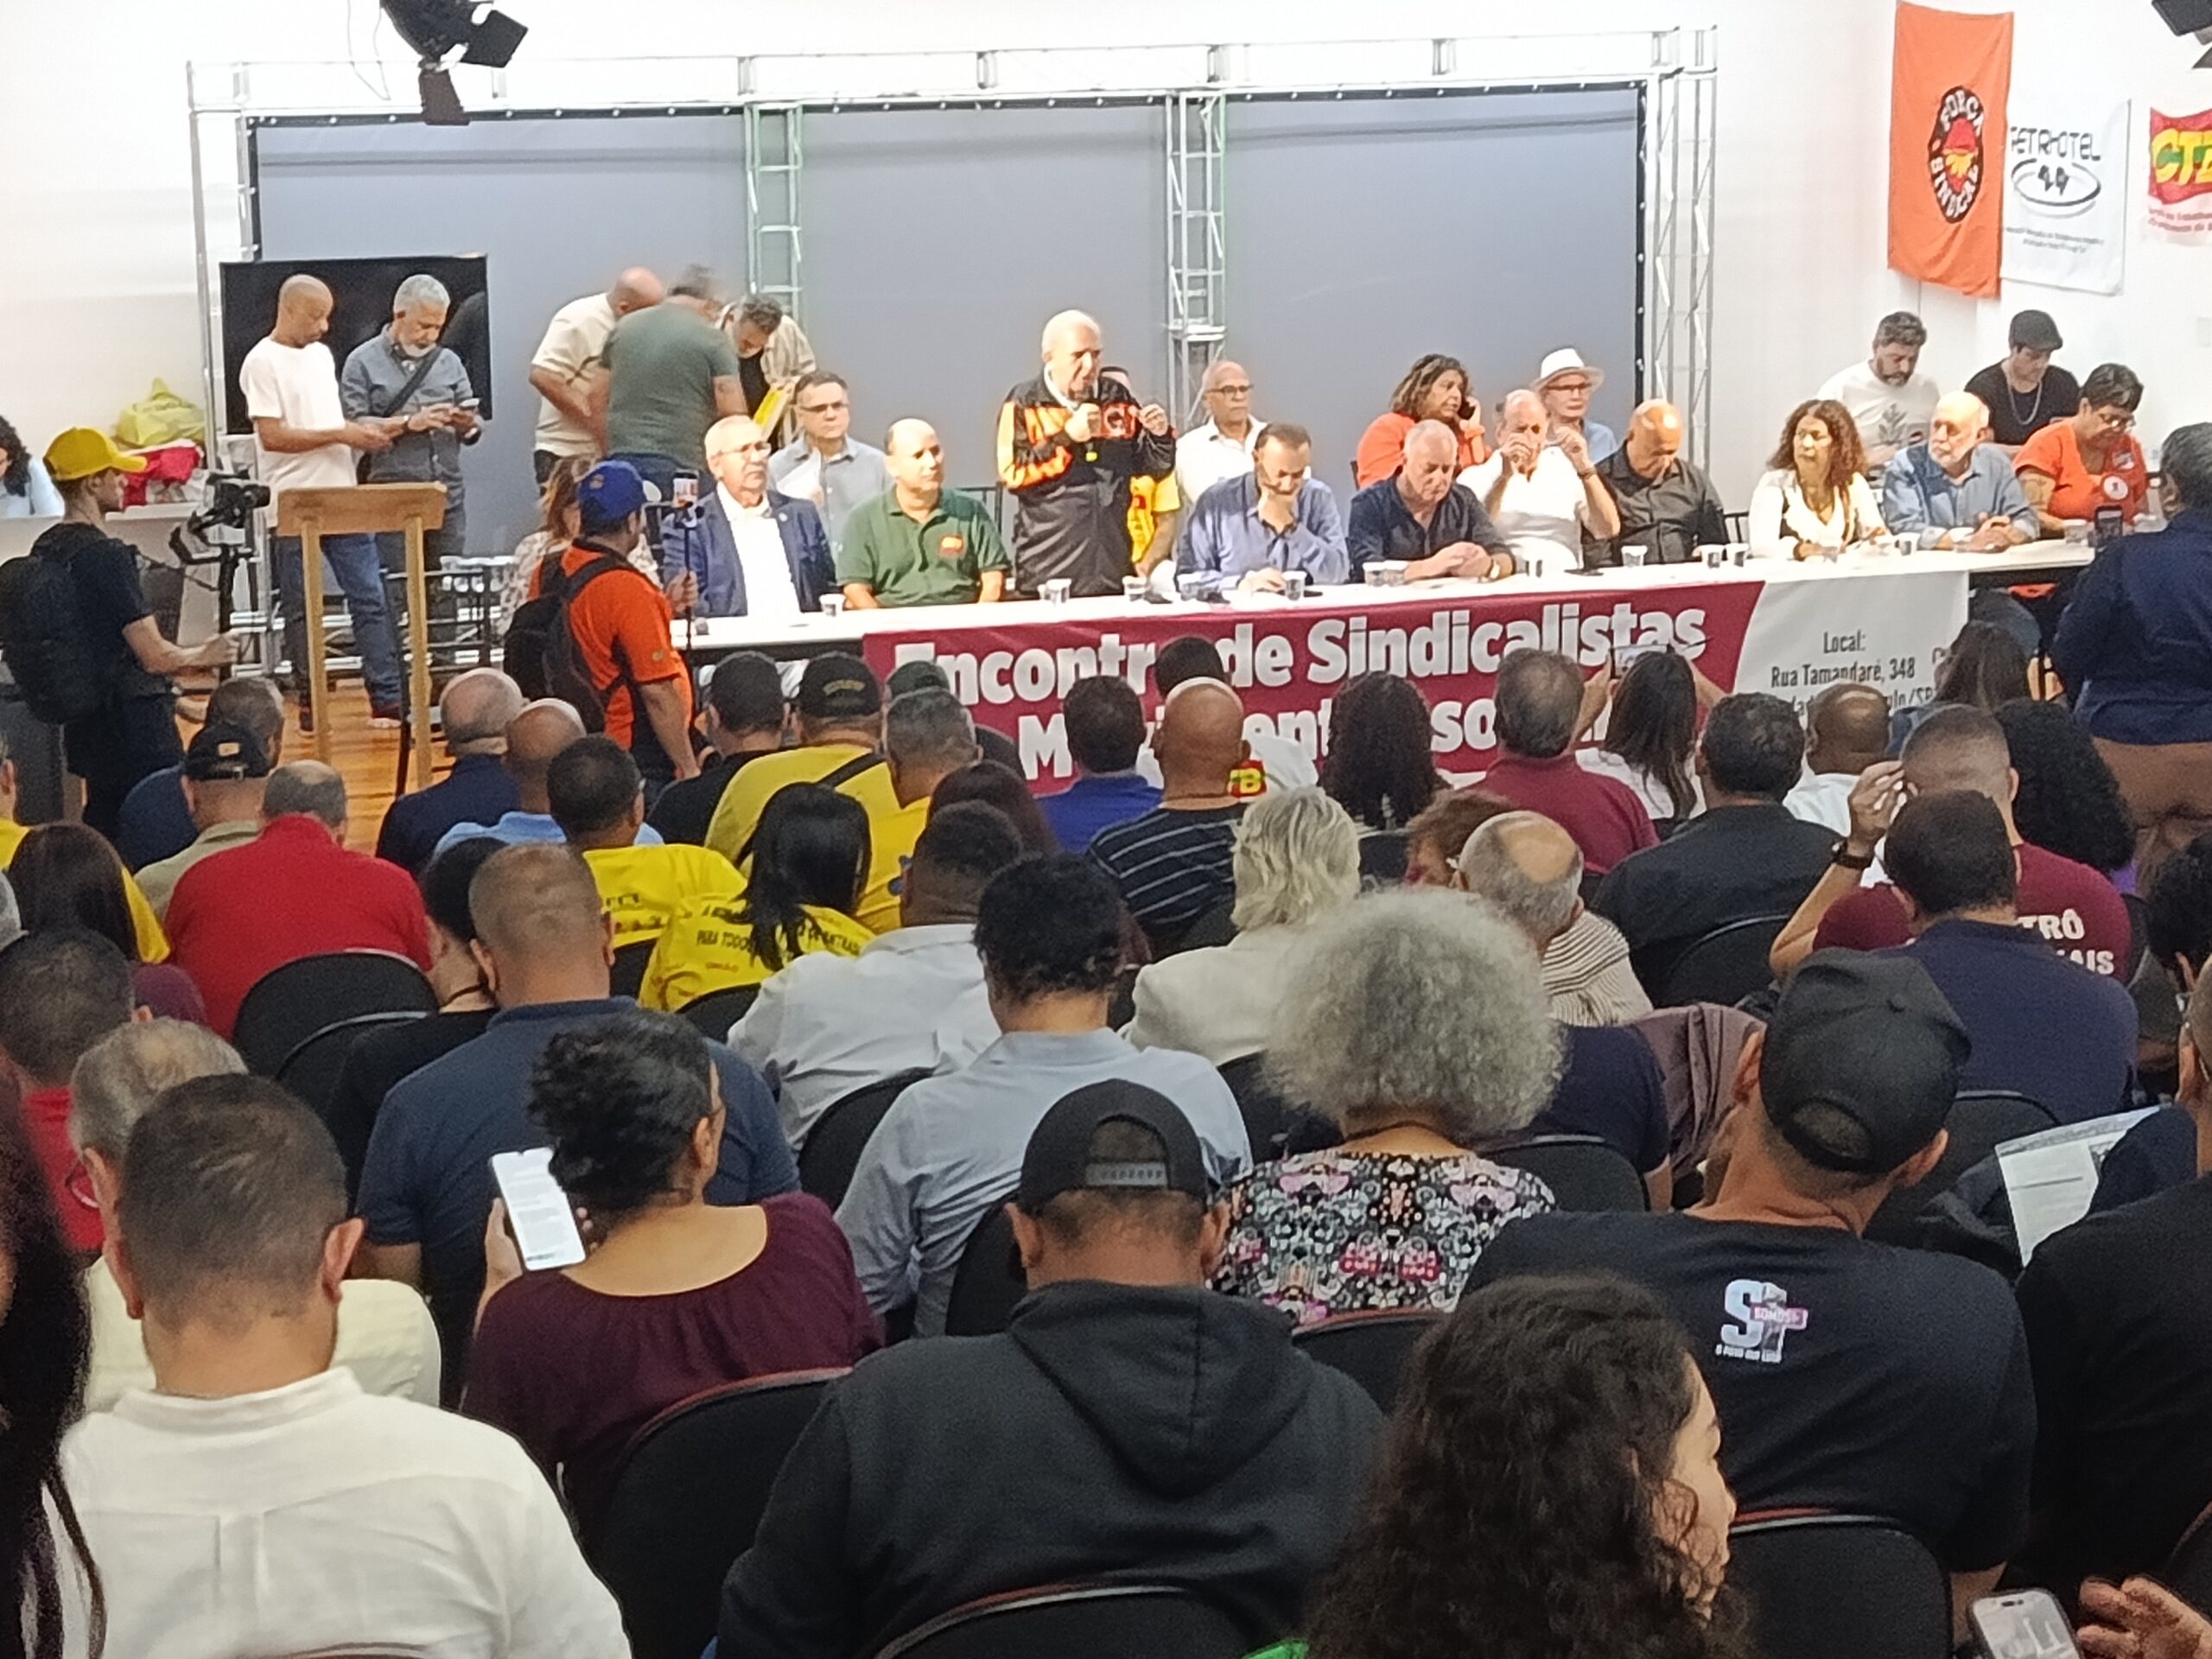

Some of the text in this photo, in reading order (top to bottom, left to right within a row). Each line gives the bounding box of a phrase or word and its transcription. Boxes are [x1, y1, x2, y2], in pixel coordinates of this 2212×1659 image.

[894, 602, 1707, 706] ncontr de Sindicalistas
[1823, 630, 1866, 654] Local:
[1771, 666, 1798, 688] Rua
[1889, 657, 1916, 680] 348
[2017, 908, 2085, 940] TRÔ
